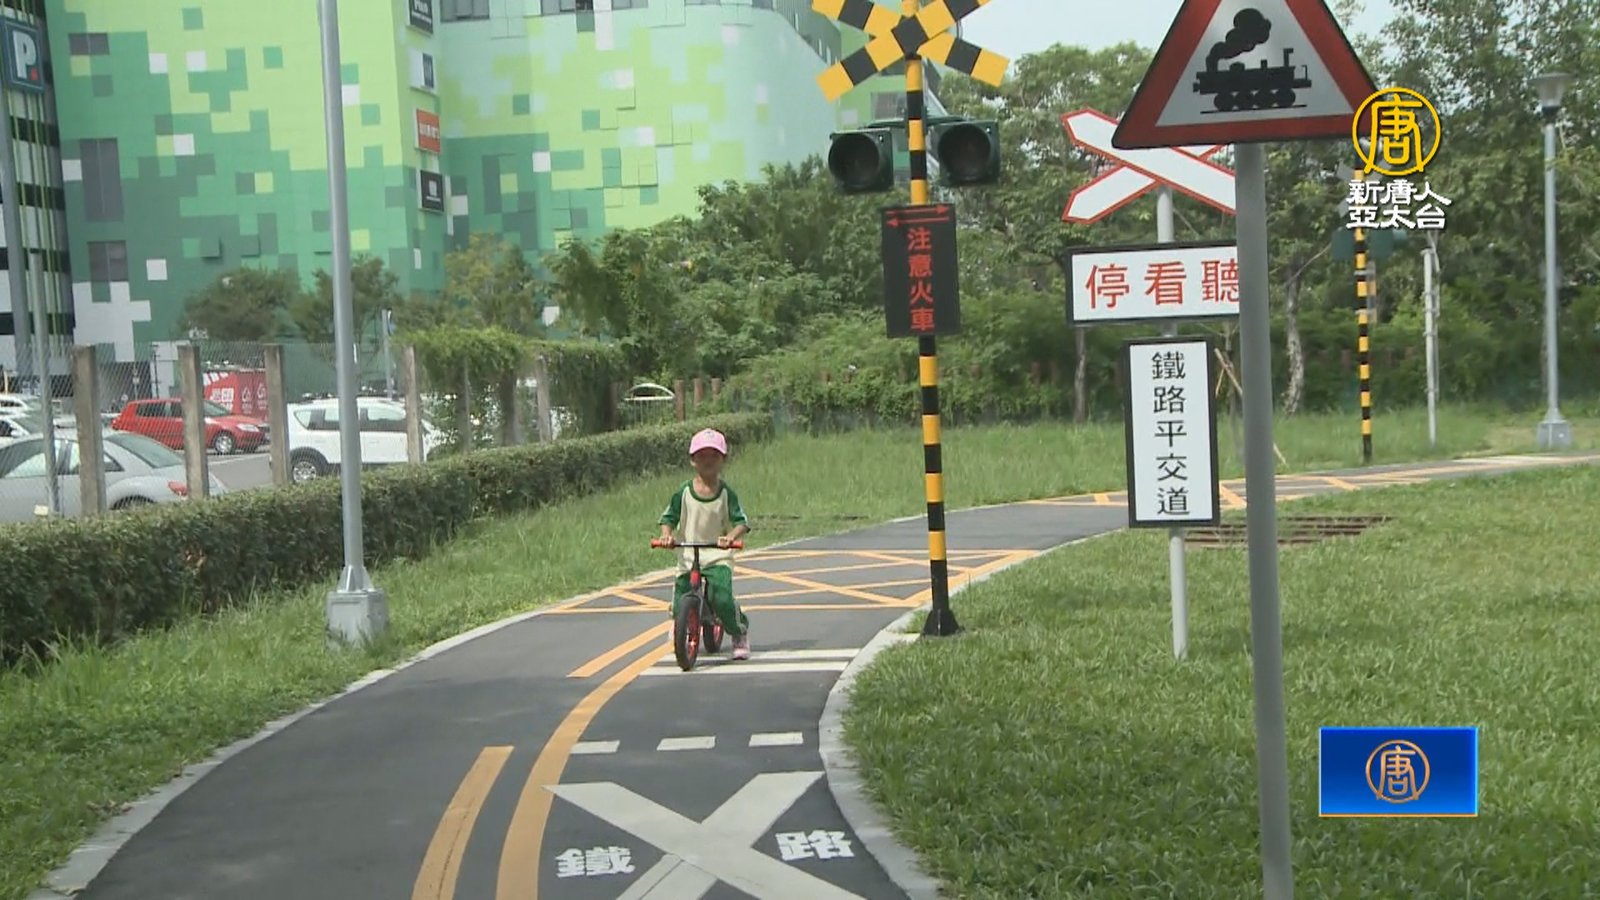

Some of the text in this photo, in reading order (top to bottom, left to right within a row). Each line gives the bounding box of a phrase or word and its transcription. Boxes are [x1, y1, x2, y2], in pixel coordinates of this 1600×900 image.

[907, 227, 935, 331] 注意火車
[1085, 258, 1240, 310] 停看聽
[1151, 351, 1190, 516] 鐵路平交道
[554, 830, 856, 878] 鐵 路
